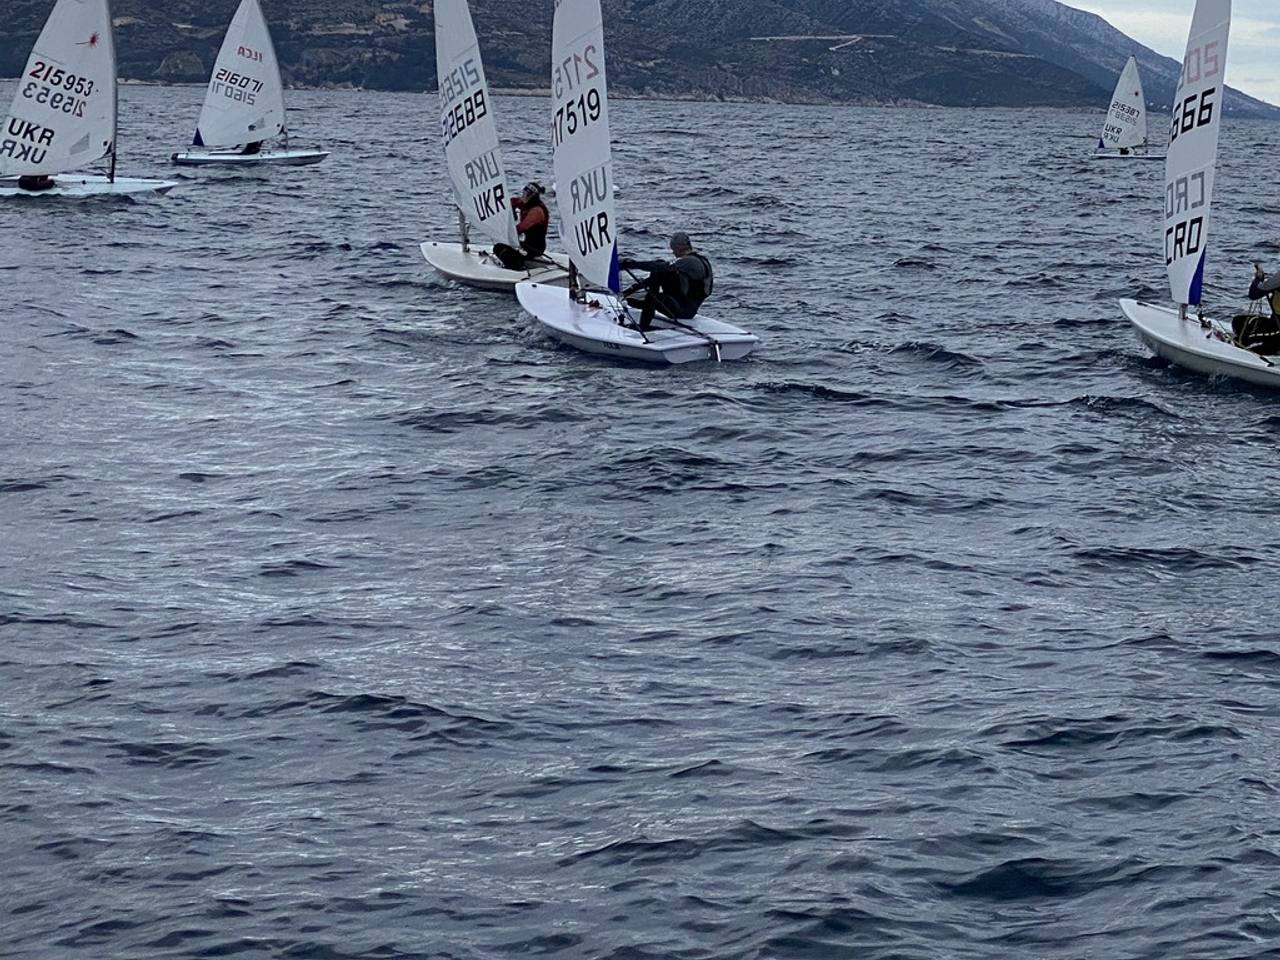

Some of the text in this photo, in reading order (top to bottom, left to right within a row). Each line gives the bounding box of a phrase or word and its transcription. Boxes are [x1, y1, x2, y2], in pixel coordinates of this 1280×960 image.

[29, 61, 94, 97] 215953
[216, 68, 264, 93] 216071
[8, 118, 55, 147] UKR
[473, 184, 506, 222] UKR
[575, 211, 611, 257] UKR
[1166, 216, 1203, 266] CRO
